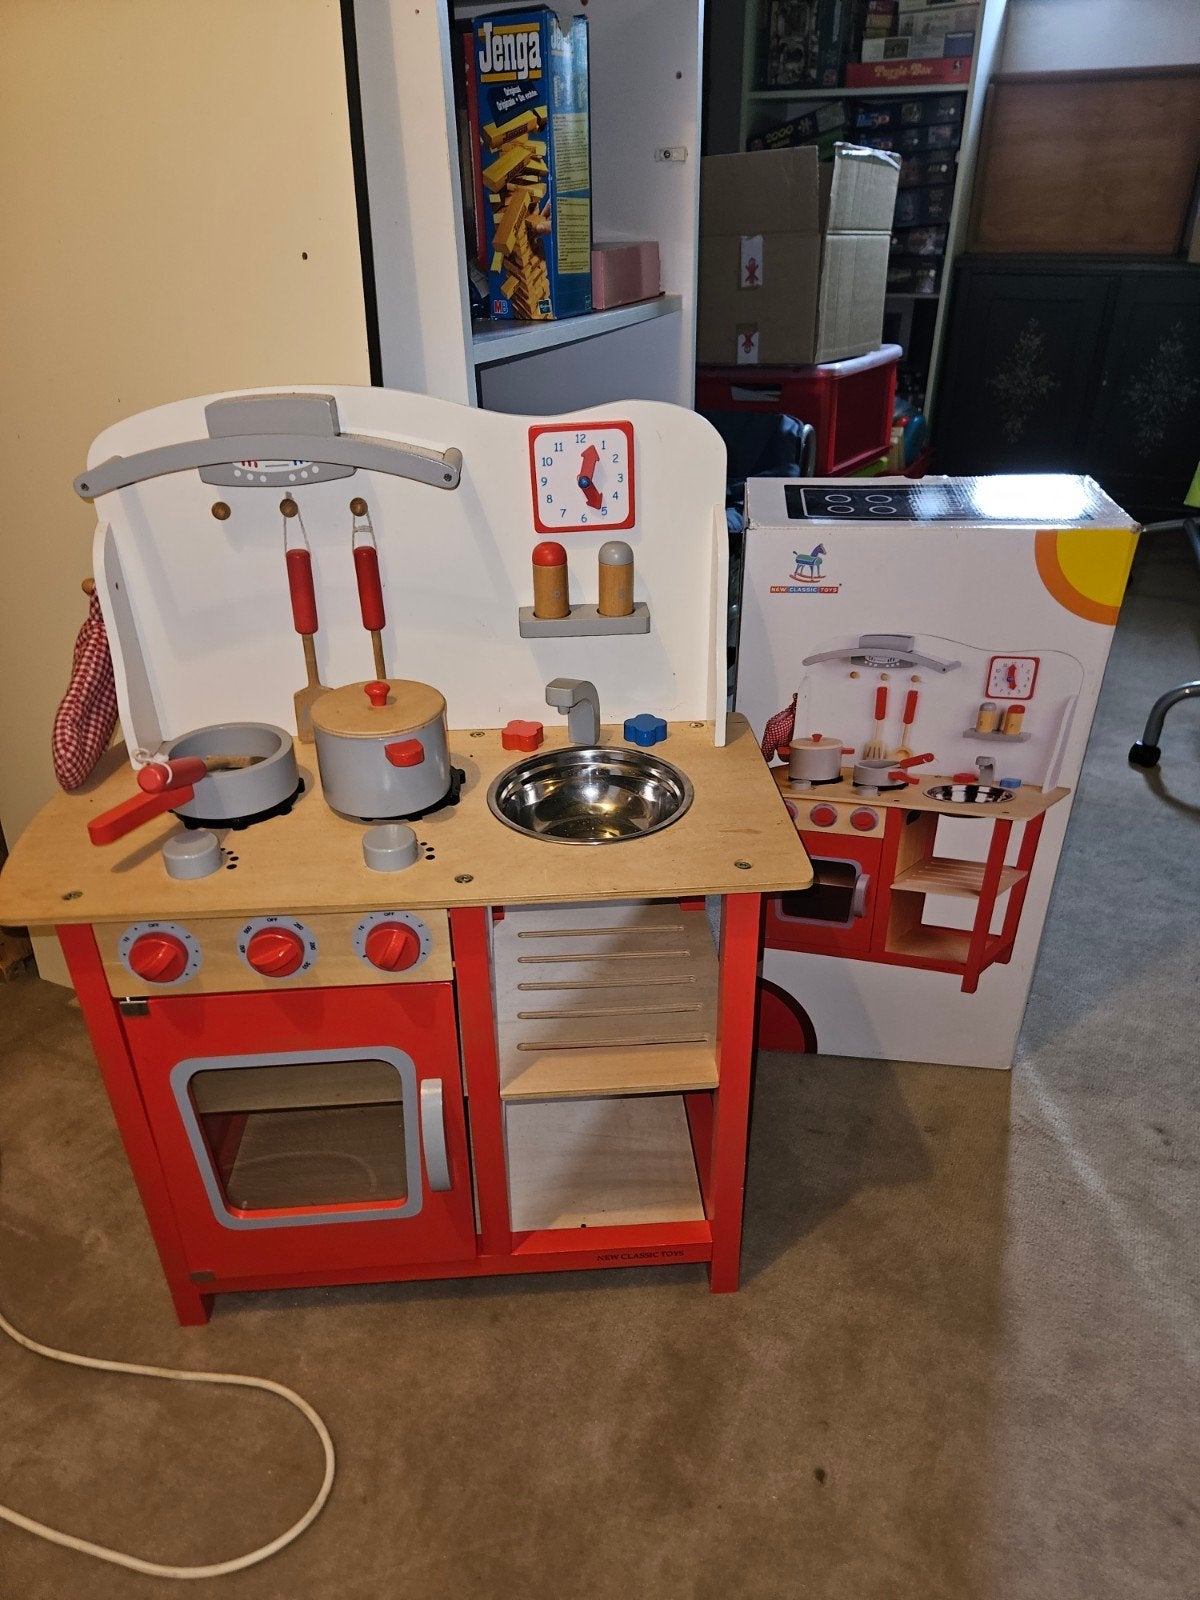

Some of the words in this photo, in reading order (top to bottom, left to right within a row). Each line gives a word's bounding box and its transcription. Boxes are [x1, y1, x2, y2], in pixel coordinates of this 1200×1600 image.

[479, 22, 542, 80] Jenga
[494, 300, 508, 314] MB
[575, 434, 586, 443] 12
[554, 442, 563, 452] 11
[601, 440, 606, 450] 1
[542, 457, 553, 467] 10
[612, 454, 619, 463] 2
[541, 477, 548, 486] 9
[618, 473, 624, 483] 3
[546, 494, 553, 503] 8
[612, 491, 619, 500] 4
[560, 508, 567, 518] 7
[601, 506, 608, 516] 5
[581, 513, 588, 523] 6
[620, 1251, 659, 1260] CLASSIC
[661, 1250, 684, 1258] TOYS
